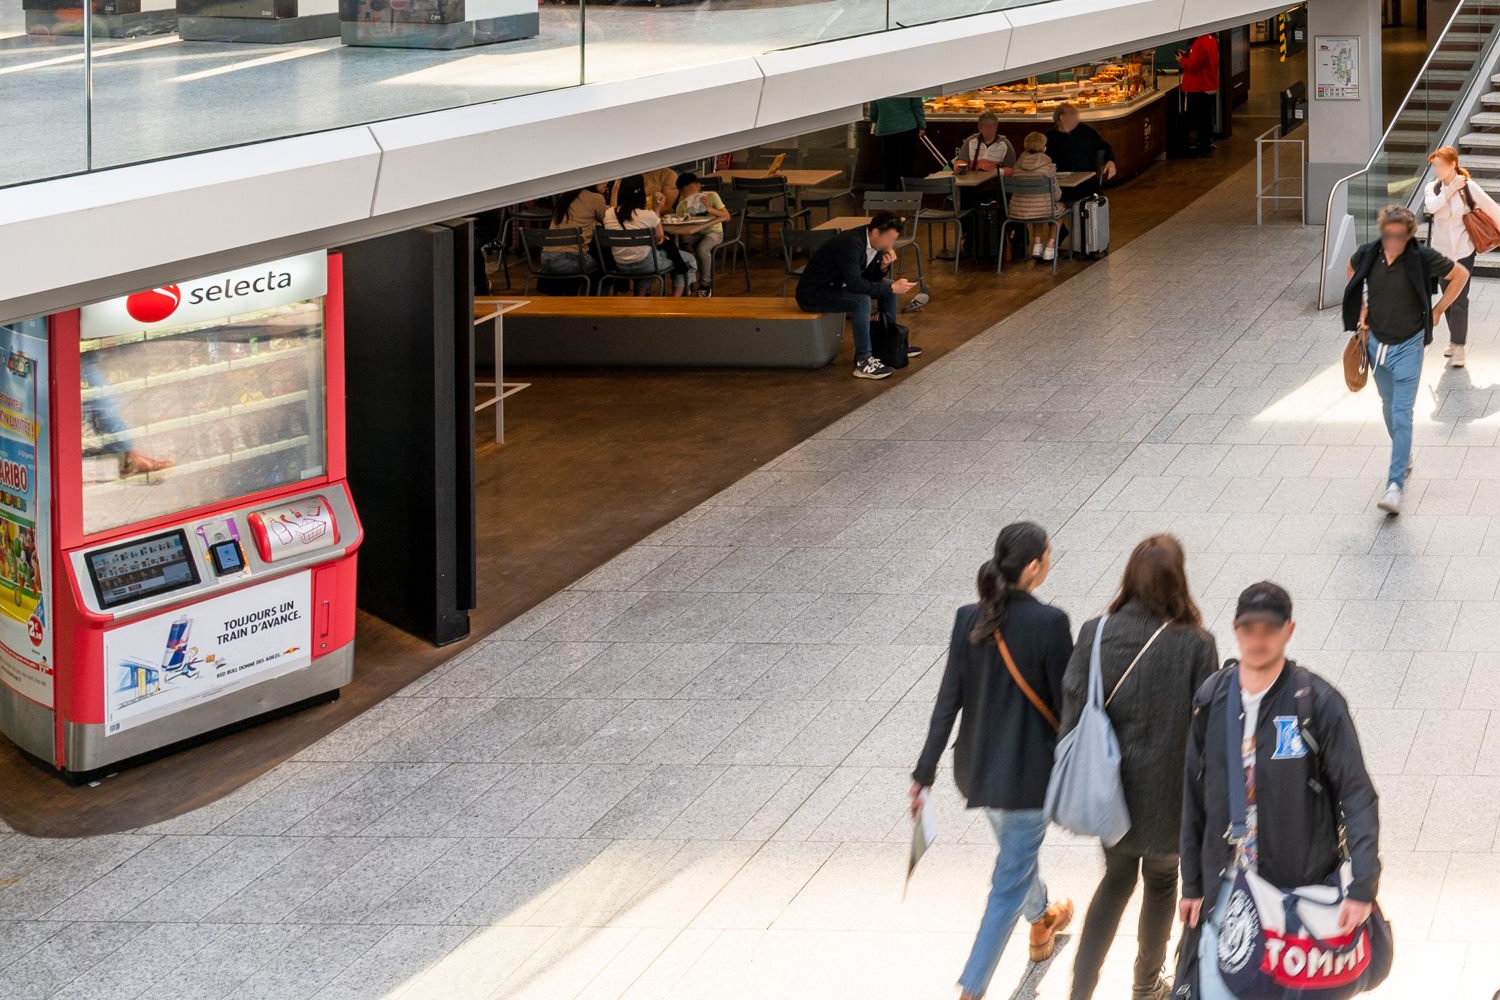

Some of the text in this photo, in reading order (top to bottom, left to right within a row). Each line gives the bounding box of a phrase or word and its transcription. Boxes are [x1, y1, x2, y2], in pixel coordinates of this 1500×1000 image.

[188, 271, 292, 305] selecta
[224, 600, 295, 632] TOUJOURS UN
[217, 627, 248, 645] TRAIN
[216, 671, 226, 679] RED
[227, 667, 238, 675] BULL
[238, 661, 256, 671] DONNE
